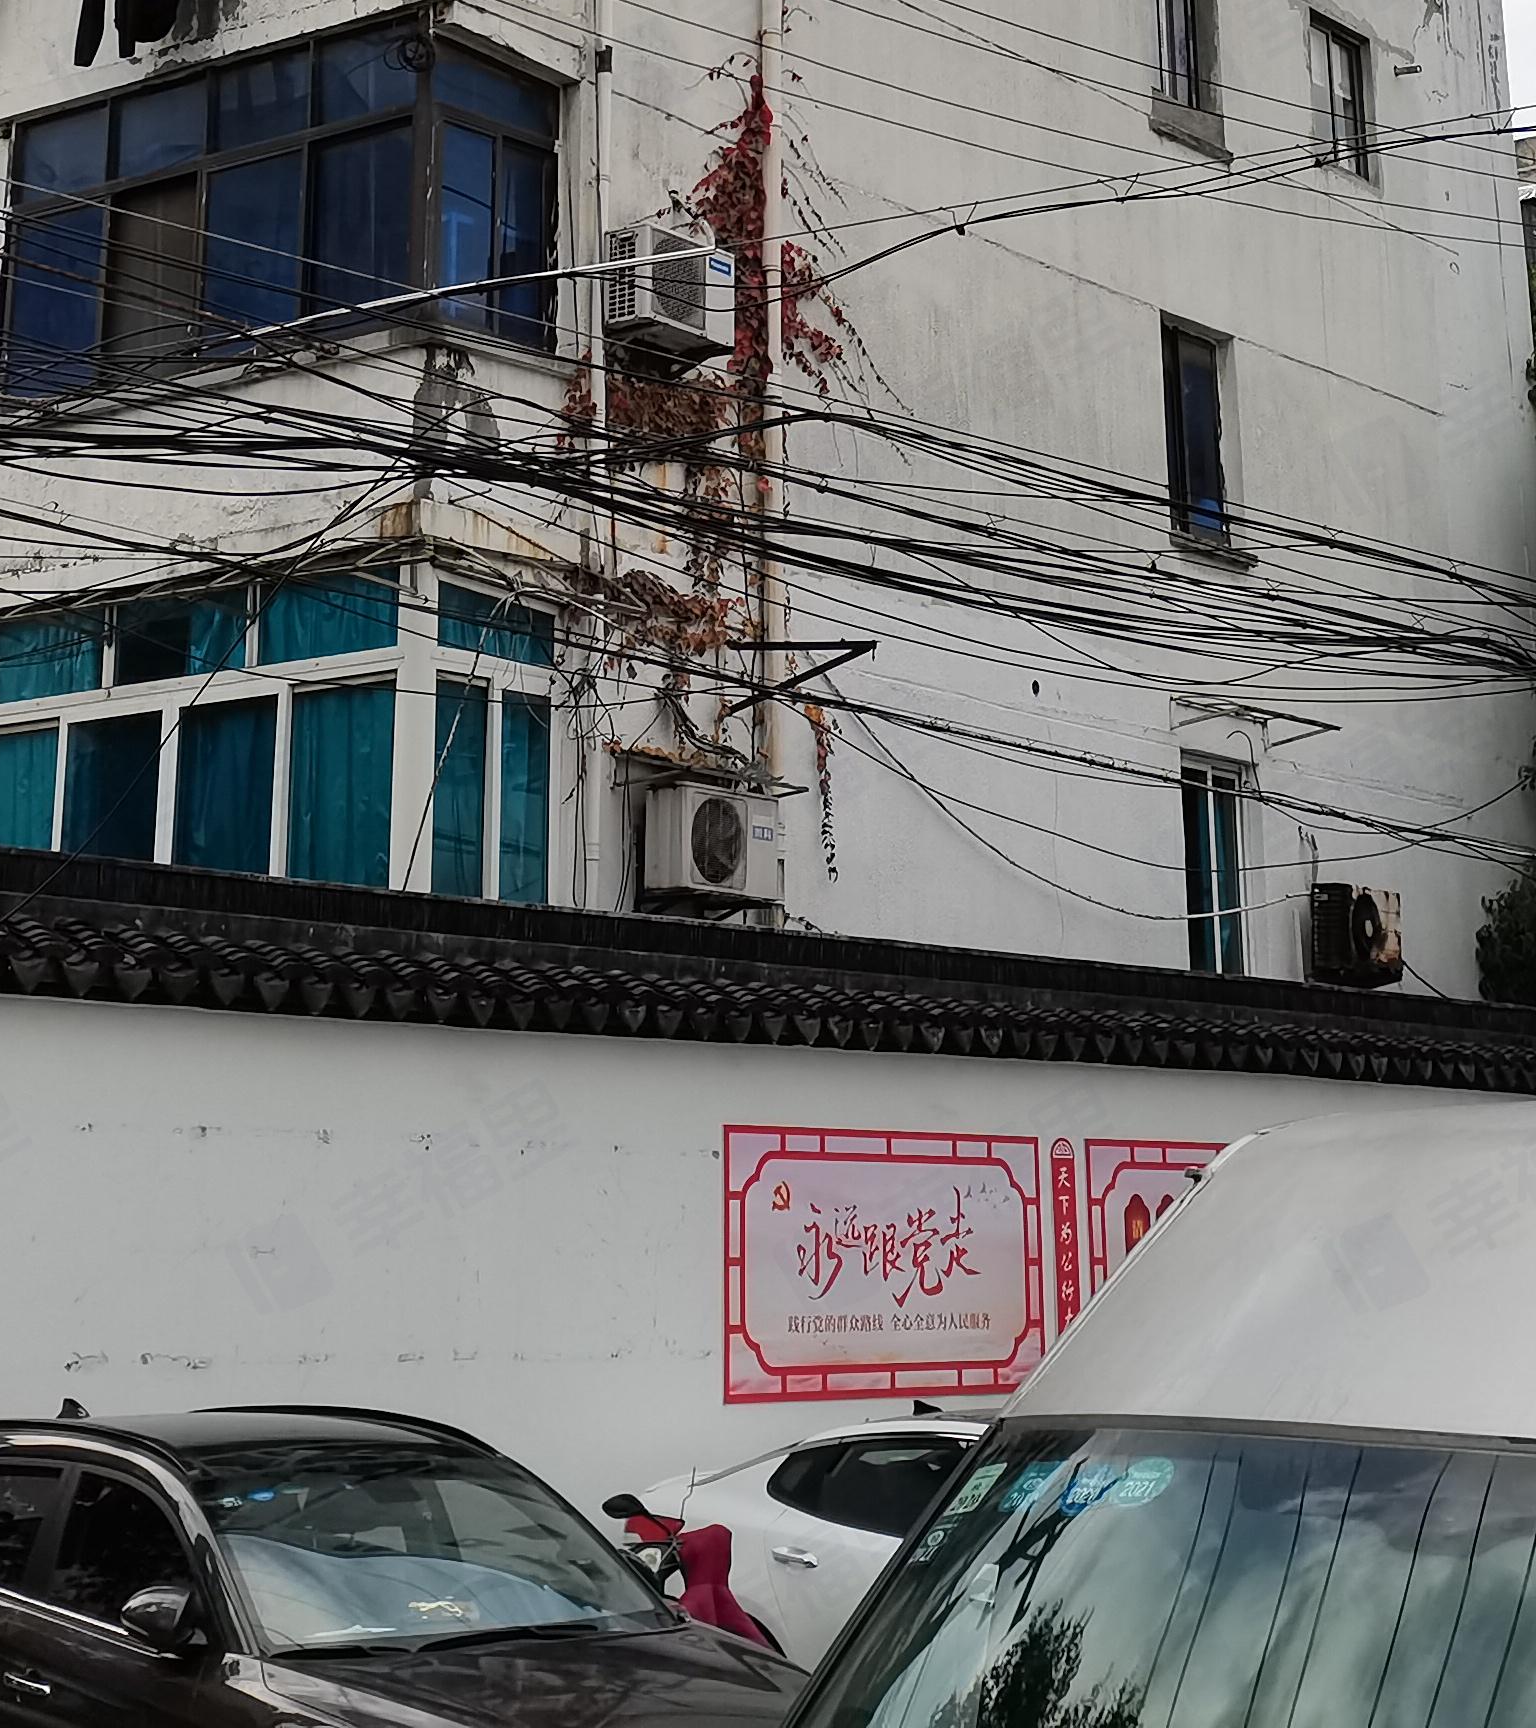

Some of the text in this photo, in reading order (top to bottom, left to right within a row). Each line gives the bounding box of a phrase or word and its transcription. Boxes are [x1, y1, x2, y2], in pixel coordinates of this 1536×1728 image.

[796, 1185, 982, 1308] 永远跟党走
[788, 1312, 991, 1334] 践行党的群众路线 全心全意为人民服务
